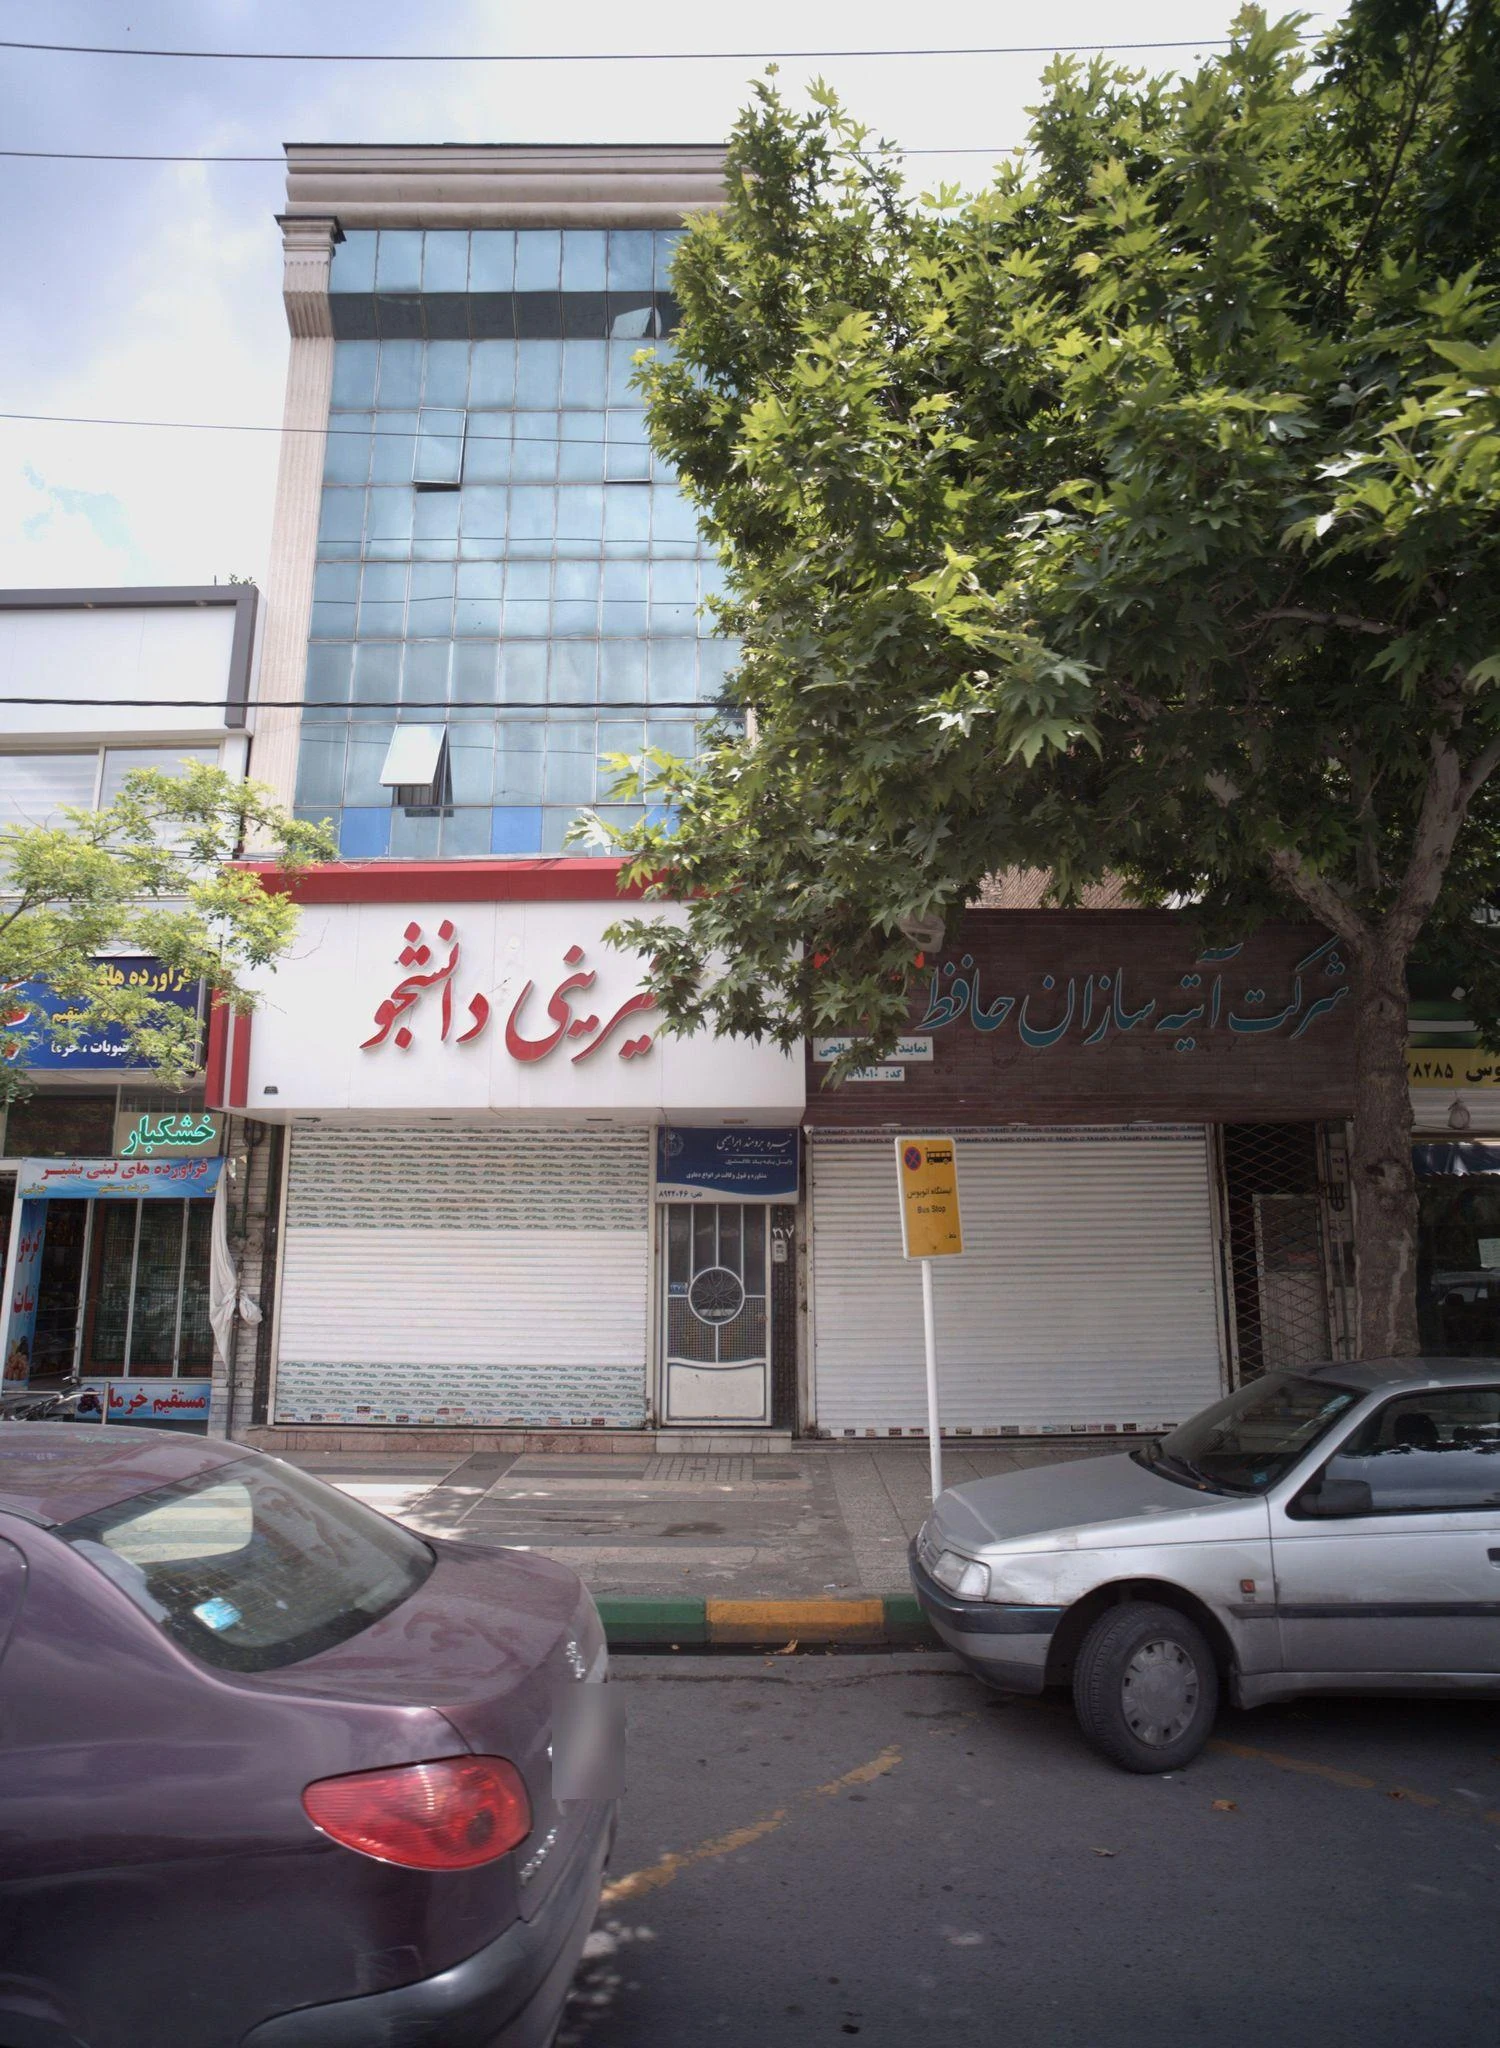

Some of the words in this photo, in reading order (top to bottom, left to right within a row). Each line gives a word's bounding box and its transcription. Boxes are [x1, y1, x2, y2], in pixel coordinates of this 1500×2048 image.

[359, 919, 490, 1051] دانشجو
[505, 944, 660, 1063] یرینی
[914, 953, 1016, 1031] حافظ
[1229, 935, 1349, 1040] شرکت
[1019, 967, 1156, 1048] سازان
[121, 1114, 216, 1155] خشکبار
[87, 1161, 118, 1180] لبنی
[121, 1160, 150, 1180] های
[917, 1206, 930, 1214] Bus
[931, 1205, 946, 1214] Stop
[107, 1387, 149, 1415] خرما
[152, 1389, 206, 1414] مستقیم
